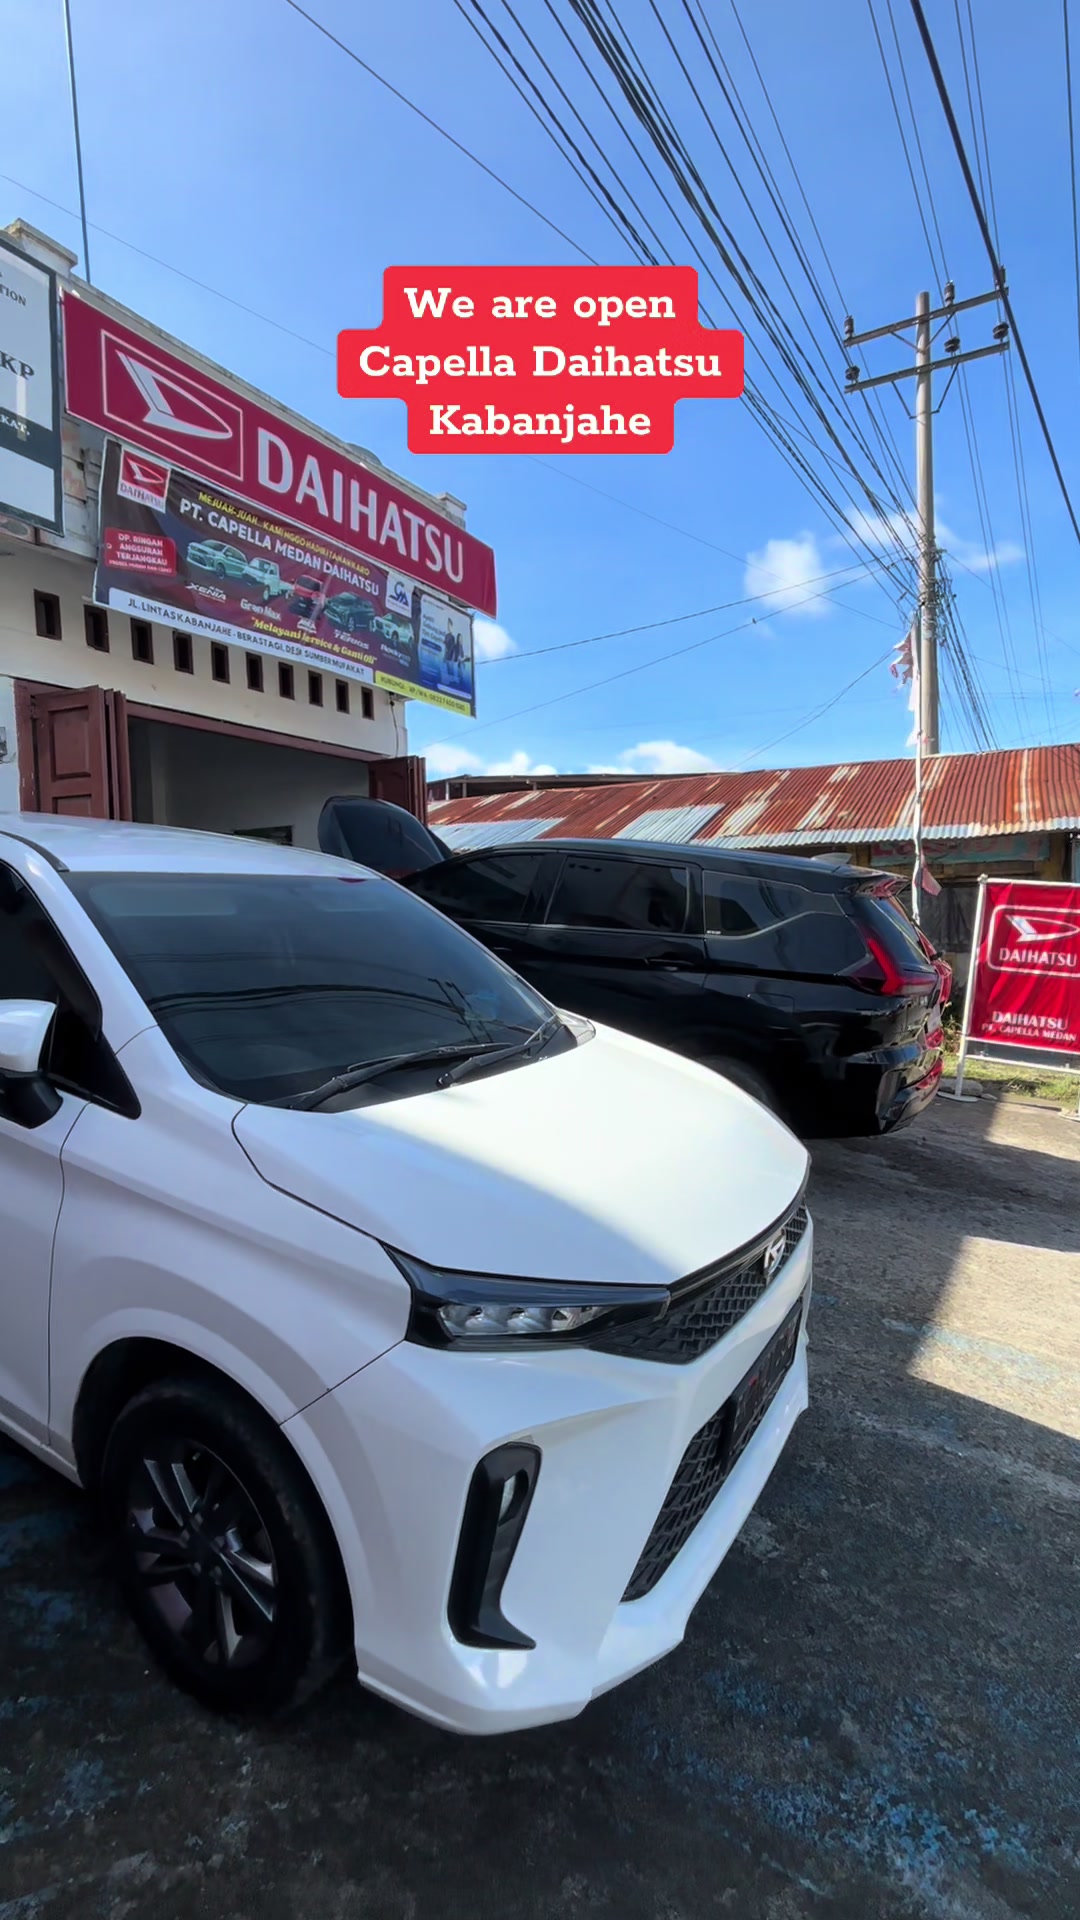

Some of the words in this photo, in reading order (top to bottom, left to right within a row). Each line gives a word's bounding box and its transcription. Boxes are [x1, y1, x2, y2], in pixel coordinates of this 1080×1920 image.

[120, 483, 164, 509] DAIHATSU
[257, 426, 464, 583] DAIHATSU
[120, 543, 163, 556] ANGSURAN
[180, 498, 203, 521] PT.
[208, 511, 272, 550] CAPELLA
[274, 540, 321, 570] MEDAN
[323, 560, 379, 596] DAIHATSU
[116, 552, 168, 566] TERJANGKAU
[186, 582, 226, 600] XENIA
[999, 948, 1077, 967] DAIHATSU
[992, 1010, 1069, 1031] DAIHATSU
[999, 1025, 1040, 1038] CAPELLA
[1042, 1030, 1077, 1042] MEDAN
